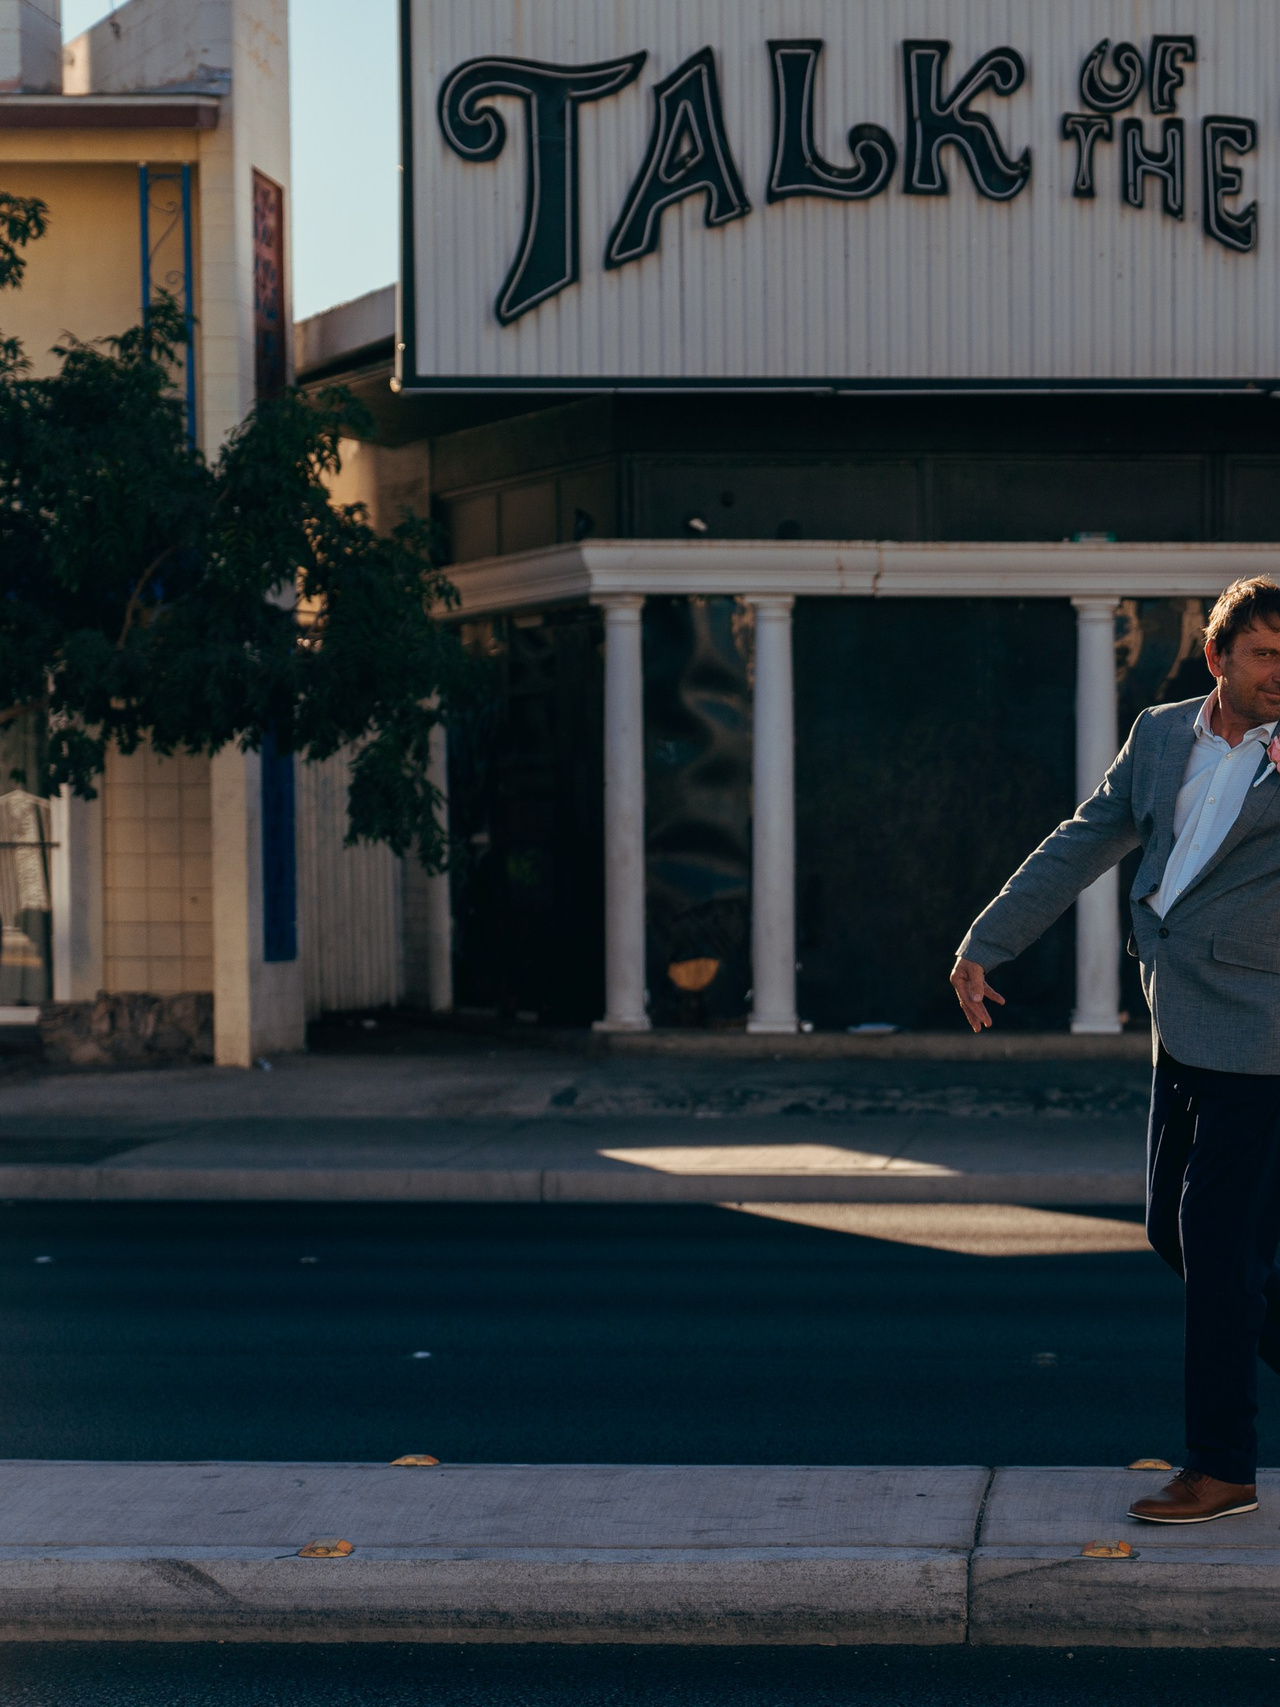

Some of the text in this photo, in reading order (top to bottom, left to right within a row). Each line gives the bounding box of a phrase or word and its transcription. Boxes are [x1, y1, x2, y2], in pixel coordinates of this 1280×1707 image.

[1080, 34, 1197, 114] OF
[438, 38, 1030, 327] TALK
[1062, 112, 1258, 252] THE
